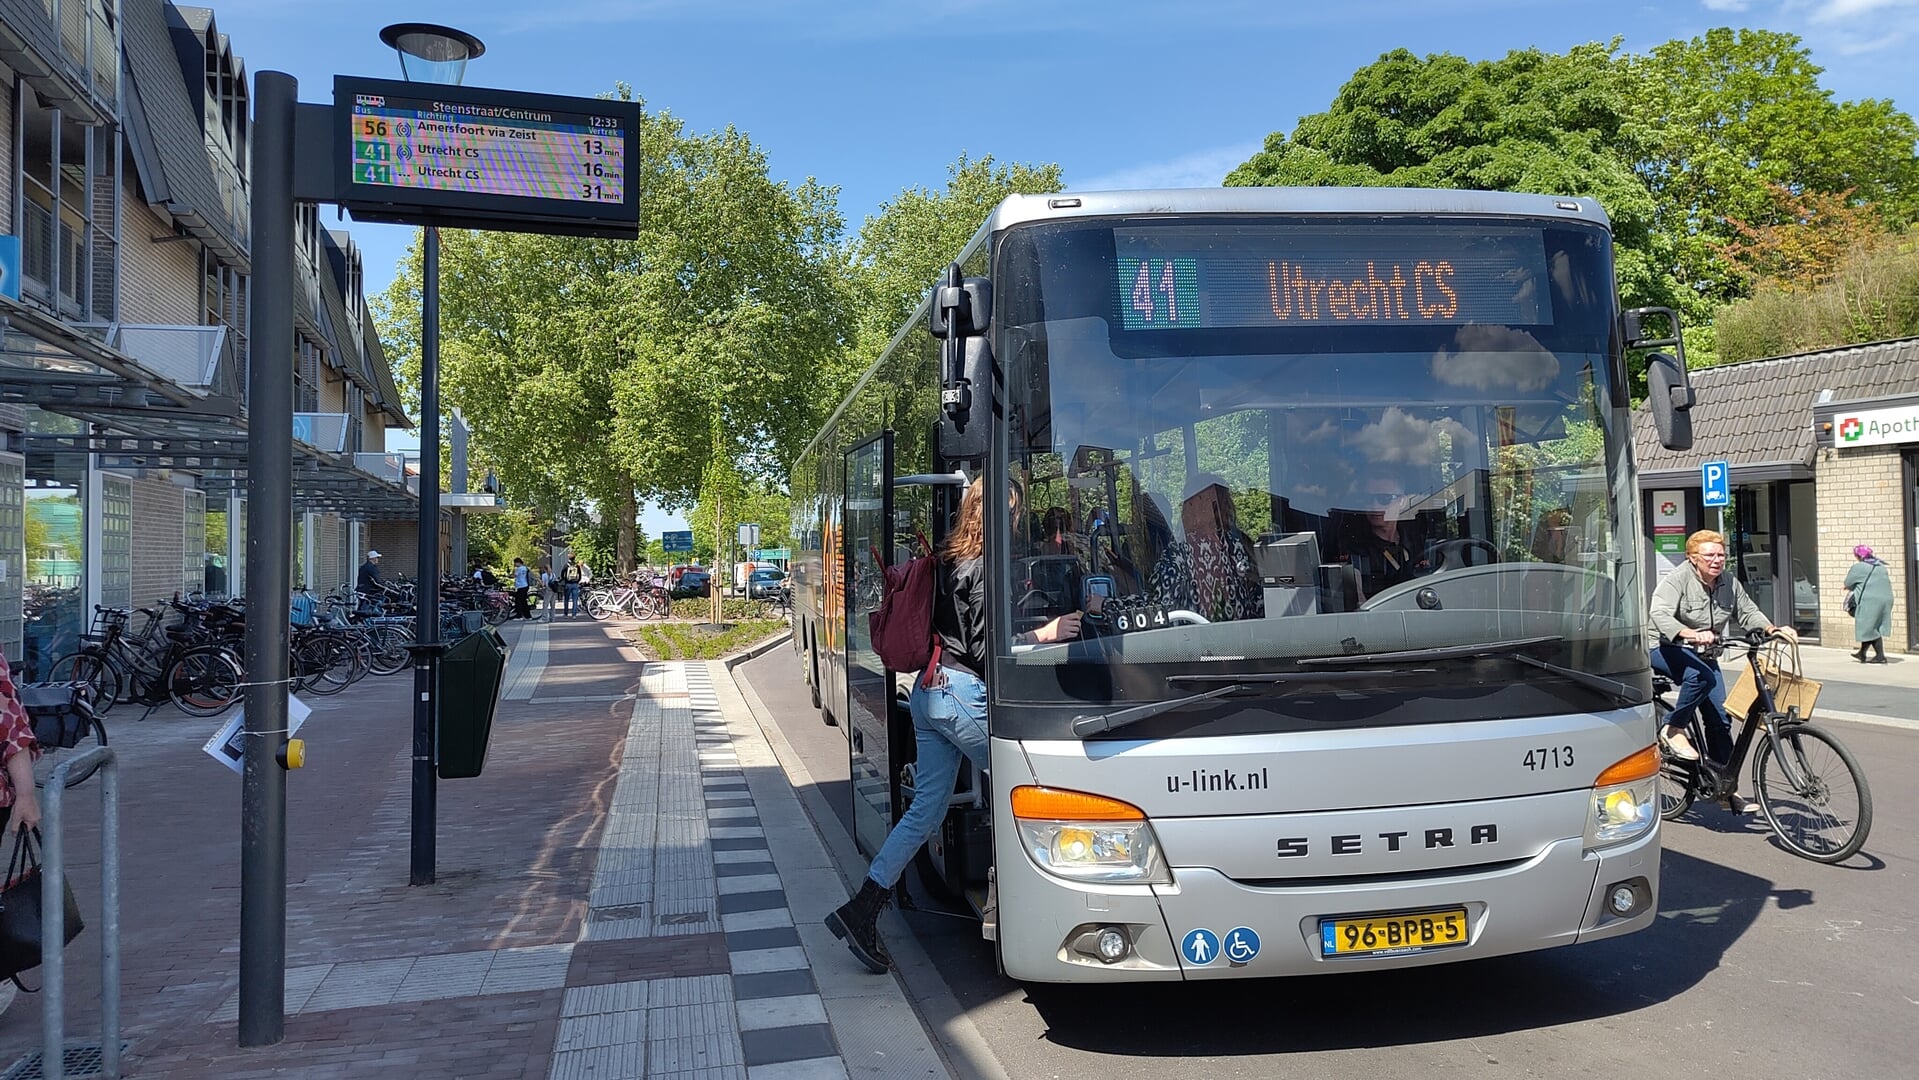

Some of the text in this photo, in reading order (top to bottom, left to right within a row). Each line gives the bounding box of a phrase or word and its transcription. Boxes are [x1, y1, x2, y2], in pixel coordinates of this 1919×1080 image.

[355, 106, 618, 137] Bus Richting Vertrek
[433, 101, 618, 128] Steenstraat/Centrum 12:33
[364, 120, 620, 157] 56 Amersfoort via Zeist 13 min
[364, 144, 620, 179] 41 Utrecht CS 16 min
[364, 165, 620, 200] 41 Utrecht CS 31 min
[1132, 260, 1458, 321] 41 Utrecht CS
[1708, 465, 1721, 488] P
[1117, 610, 1165, 630] 604
[1523, 745, 1575, 771] 4713
[1166, 767, 1269, 793] u-link.nl
[1277, 823, 1498, 858] SETRA
[1324, 915, 1459, 949] NL 96-BPB-5
